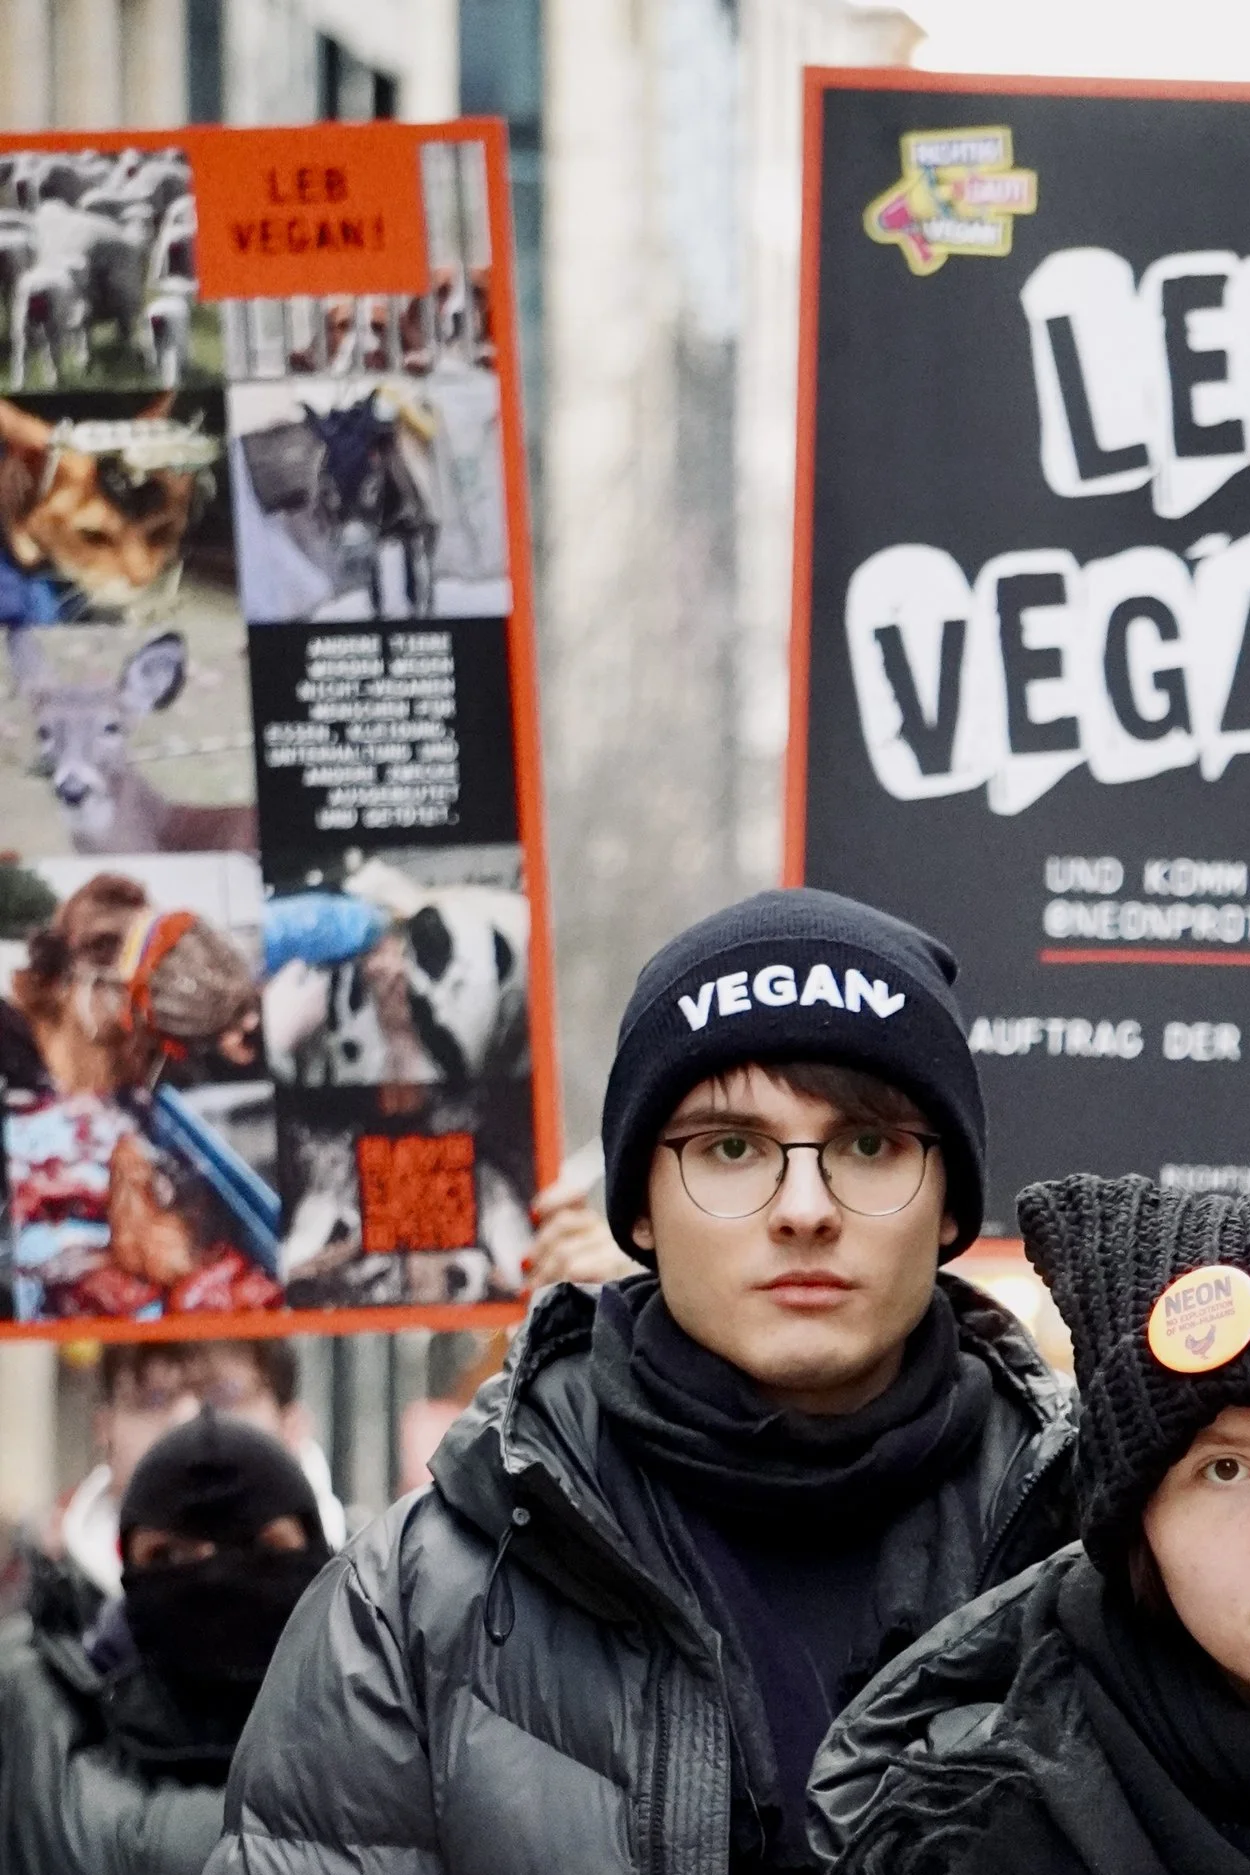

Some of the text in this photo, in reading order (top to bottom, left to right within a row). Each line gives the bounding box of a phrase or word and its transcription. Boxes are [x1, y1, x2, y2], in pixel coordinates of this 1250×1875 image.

[267, 165, 348, 206] LEB
[231, 210, 386, 254] VEGAN!
[1044, 856, 1124, 895] UND
[1142, 858, 1248, 898] KOMM
[968, 1015, 1143, 1060] AUFTRAG
[1162, 1021, 1241, 1062] DER
[1164, 1275, 1232, 1319] NEON
